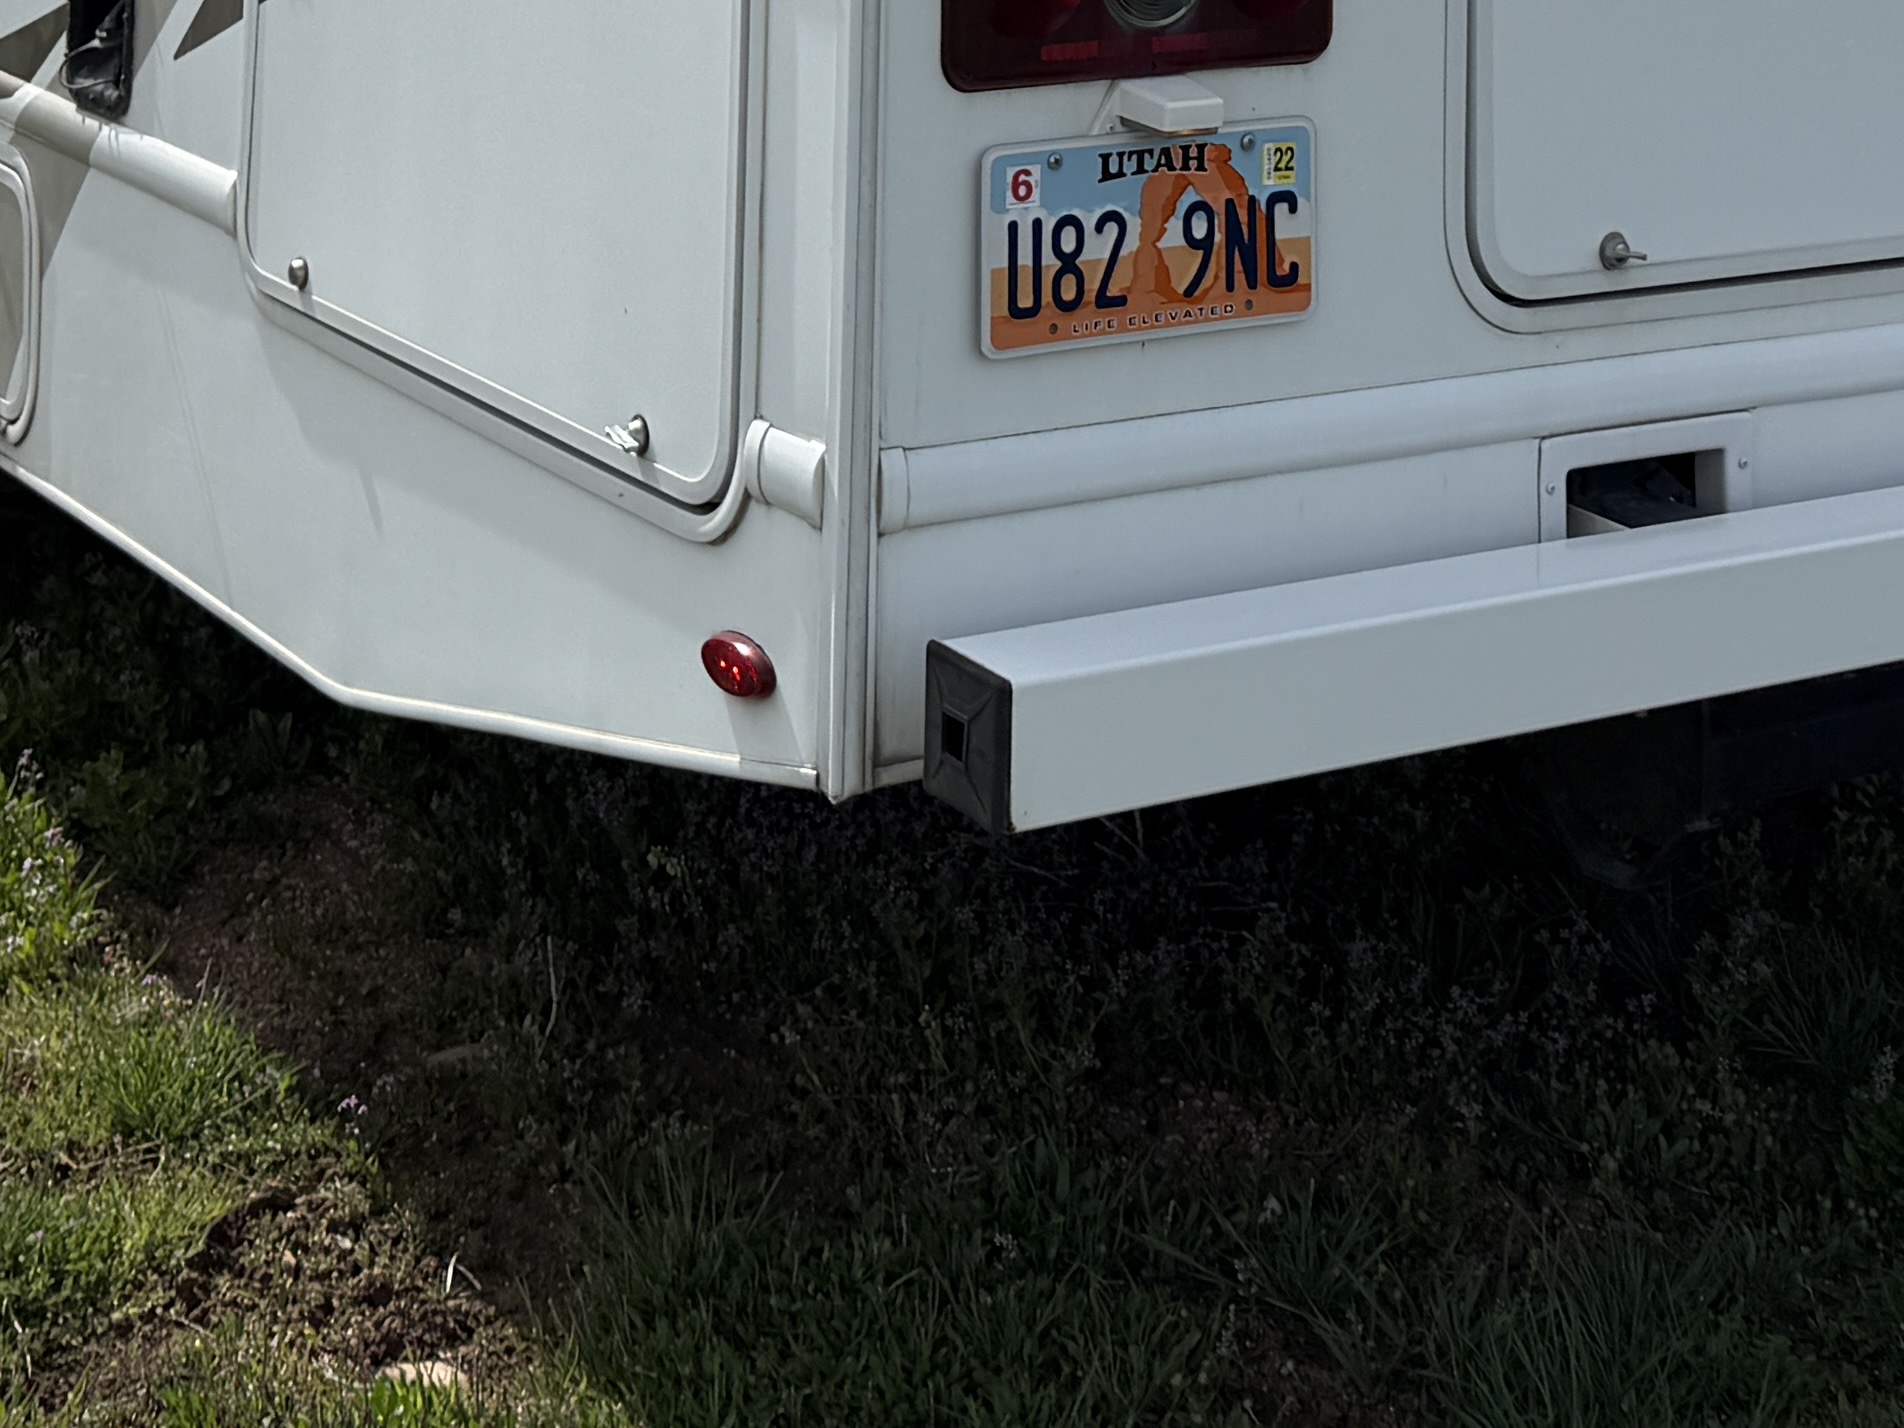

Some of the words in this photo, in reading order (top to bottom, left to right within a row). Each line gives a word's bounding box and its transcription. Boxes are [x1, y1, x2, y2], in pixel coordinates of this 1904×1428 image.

[1097, 142, 1209, 184] UTAH
[1272, 145, 1295, 173] 22
[1011, 168, 1034, 203] 6
[1007, 209, 1129, 321] U82
[1182, 189, 1300, 299] 9NC
[1071, 317, 1117, 334] LIFE
[1127, 303, 1236, 328] ELEVATED
